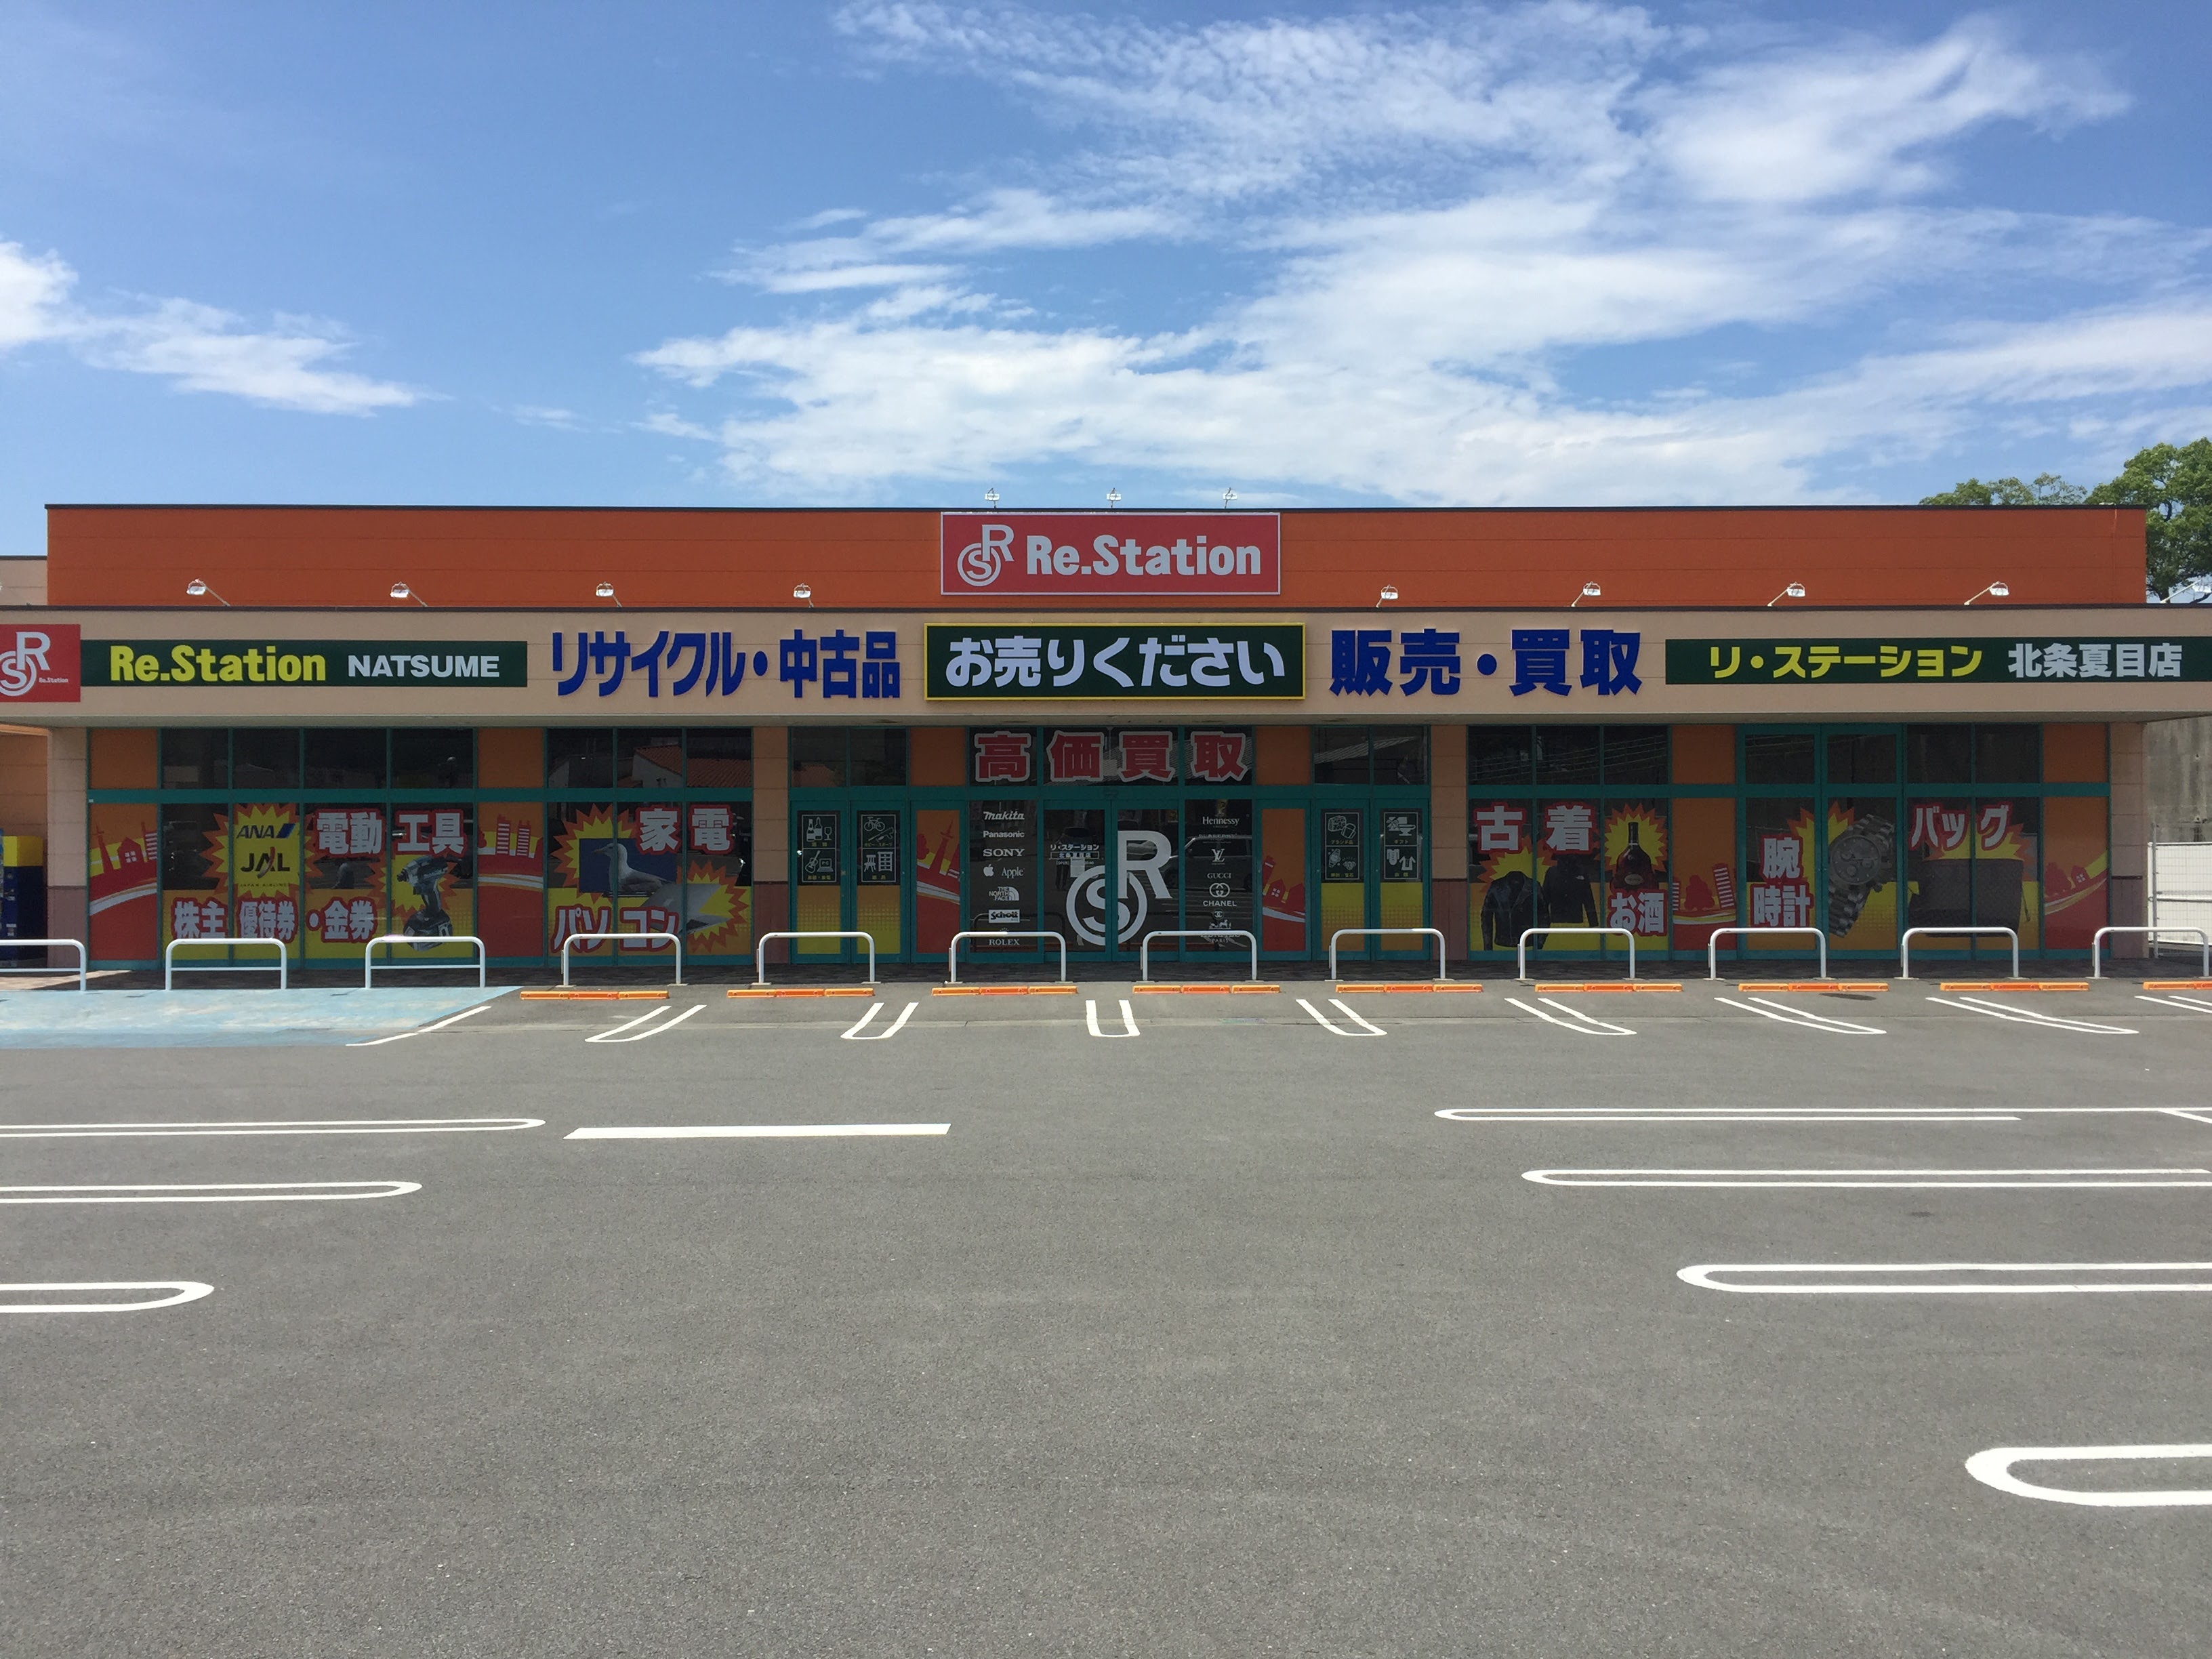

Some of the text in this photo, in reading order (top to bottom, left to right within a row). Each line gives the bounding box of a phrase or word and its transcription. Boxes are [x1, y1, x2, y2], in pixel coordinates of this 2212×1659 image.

[1027, 535, 1261, 575] Re.Station
[110, 644, 499, 682] Re.Station NATSUME
[552, 629, 900, 698] リサイクル・中古品
[946, 635, 1285, 688] お売りください
[1329, 628, 1642, 697] 販売・買取
[1711, 643, 2182, 679] リ・ステーション 北条夏目店
[974, 731, 1248, 782] 高価買取
[237, 824, 274, 839] ANA
[316, 811, 464, 855] 電動工具
[639, 807, 731, 852] 家電
[1202, 817, 1240, 826] Hennessy
[1476, 805, 1593, 851] 古着
[1911, 805, 2009, 848] バッグ
[241, 850, 290, 876] JAL
[983, 848, 1025, 857] SONY
[1002, 867, 1024, 878] Apple
[1763, 838, 1801, 879] 腕
[1610, 893, 1664, 933] お酒
[1754, 885, 1810, 926] 時計
[554, 907, 677, 949] パソコン
